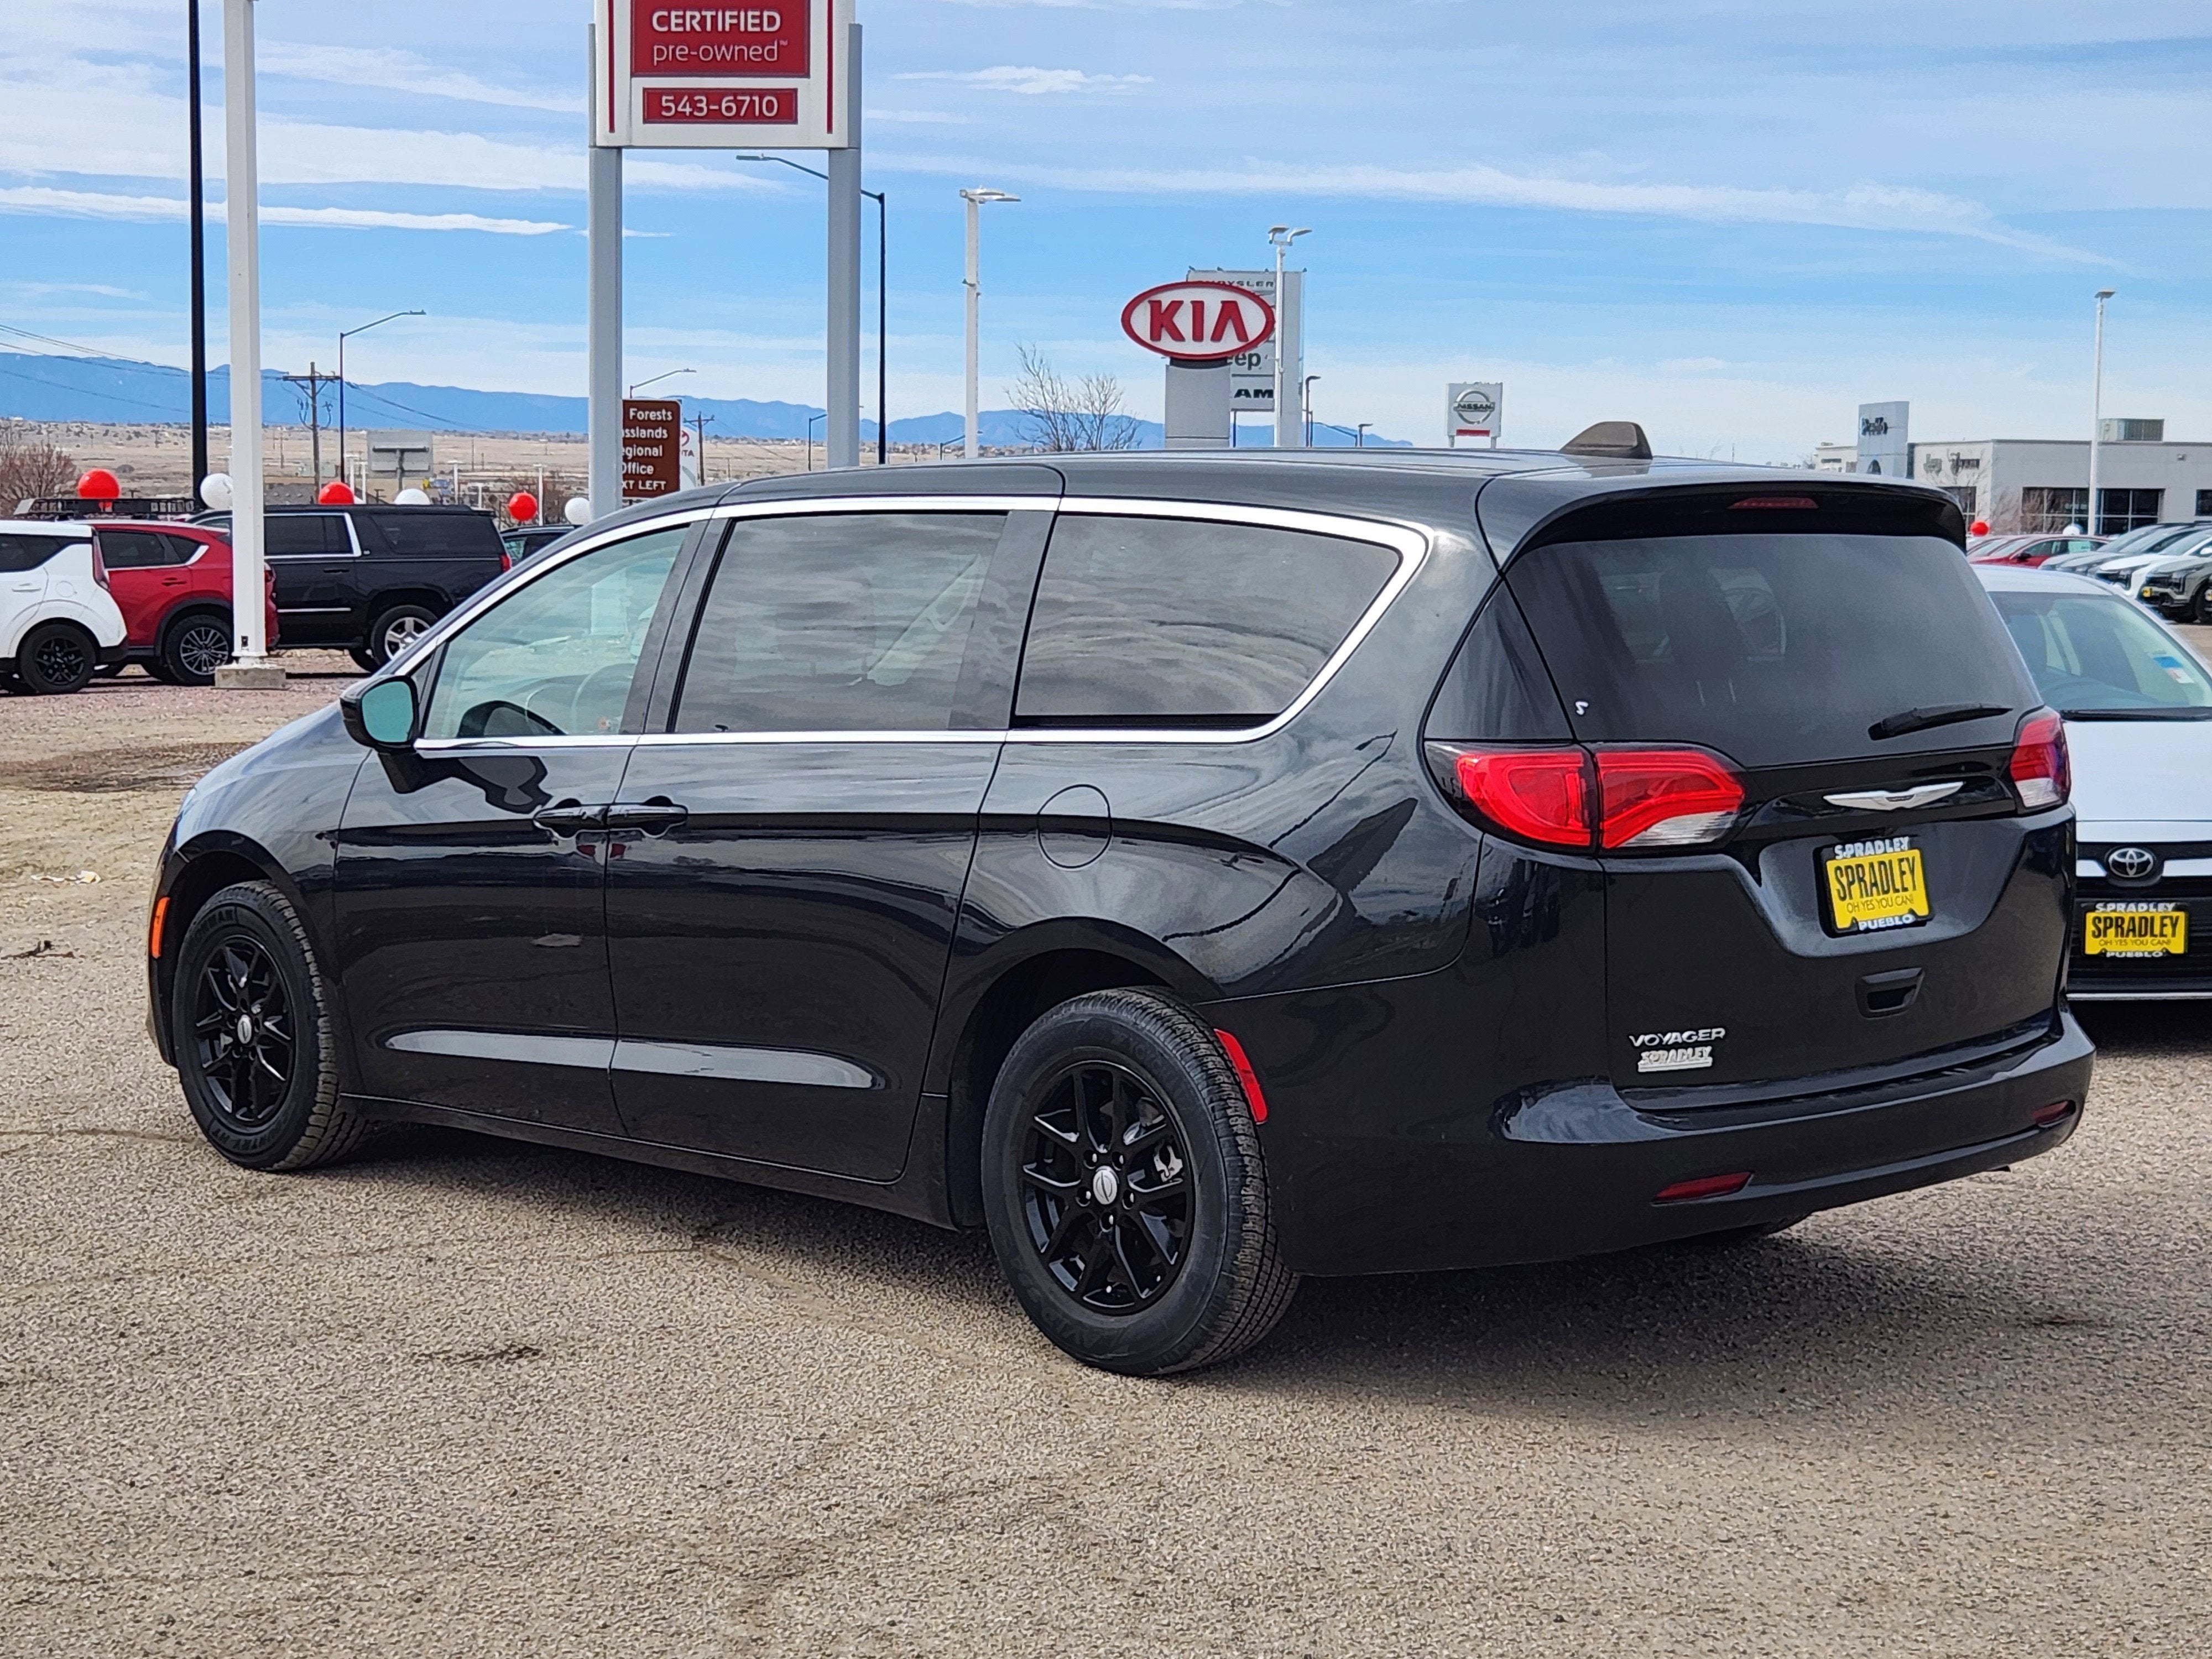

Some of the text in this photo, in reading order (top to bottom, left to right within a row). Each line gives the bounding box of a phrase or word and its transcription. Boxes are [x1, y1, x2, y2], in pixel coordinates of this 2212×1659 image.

[651, 9, 781, 32] CERTIFIED
[661, 95, 779, 117] 543-6710
[1147, 299, 1249, 342] KIA
[1234, 389, 1274, 398] AM
[629, 408, 673, 421] Forests
[622, 426, 668, 439] sslands
[622, 444, 663, 460] gional
[622, 479, 667, 491] XT LEFT
[1834, 836, 1910, 860] SPRADLEY
[1834, 855, 1917, 902] SPRADLEY
[1846, 902, 1860, 914] OH
[1861, 899, 1875, 911] YES
[1875, 896, 1893, 909] YOU
[2095, 902, 2176, 912] SPRADLEY
[1858, 914, 1916, 931] PUEBLO
[2091, 915, 2180, 939] SPRADLEY
[1629, 1027, 1726, 1047] VOYAGER
[1640, 1046, 1712, 1065] SPRADLEY
